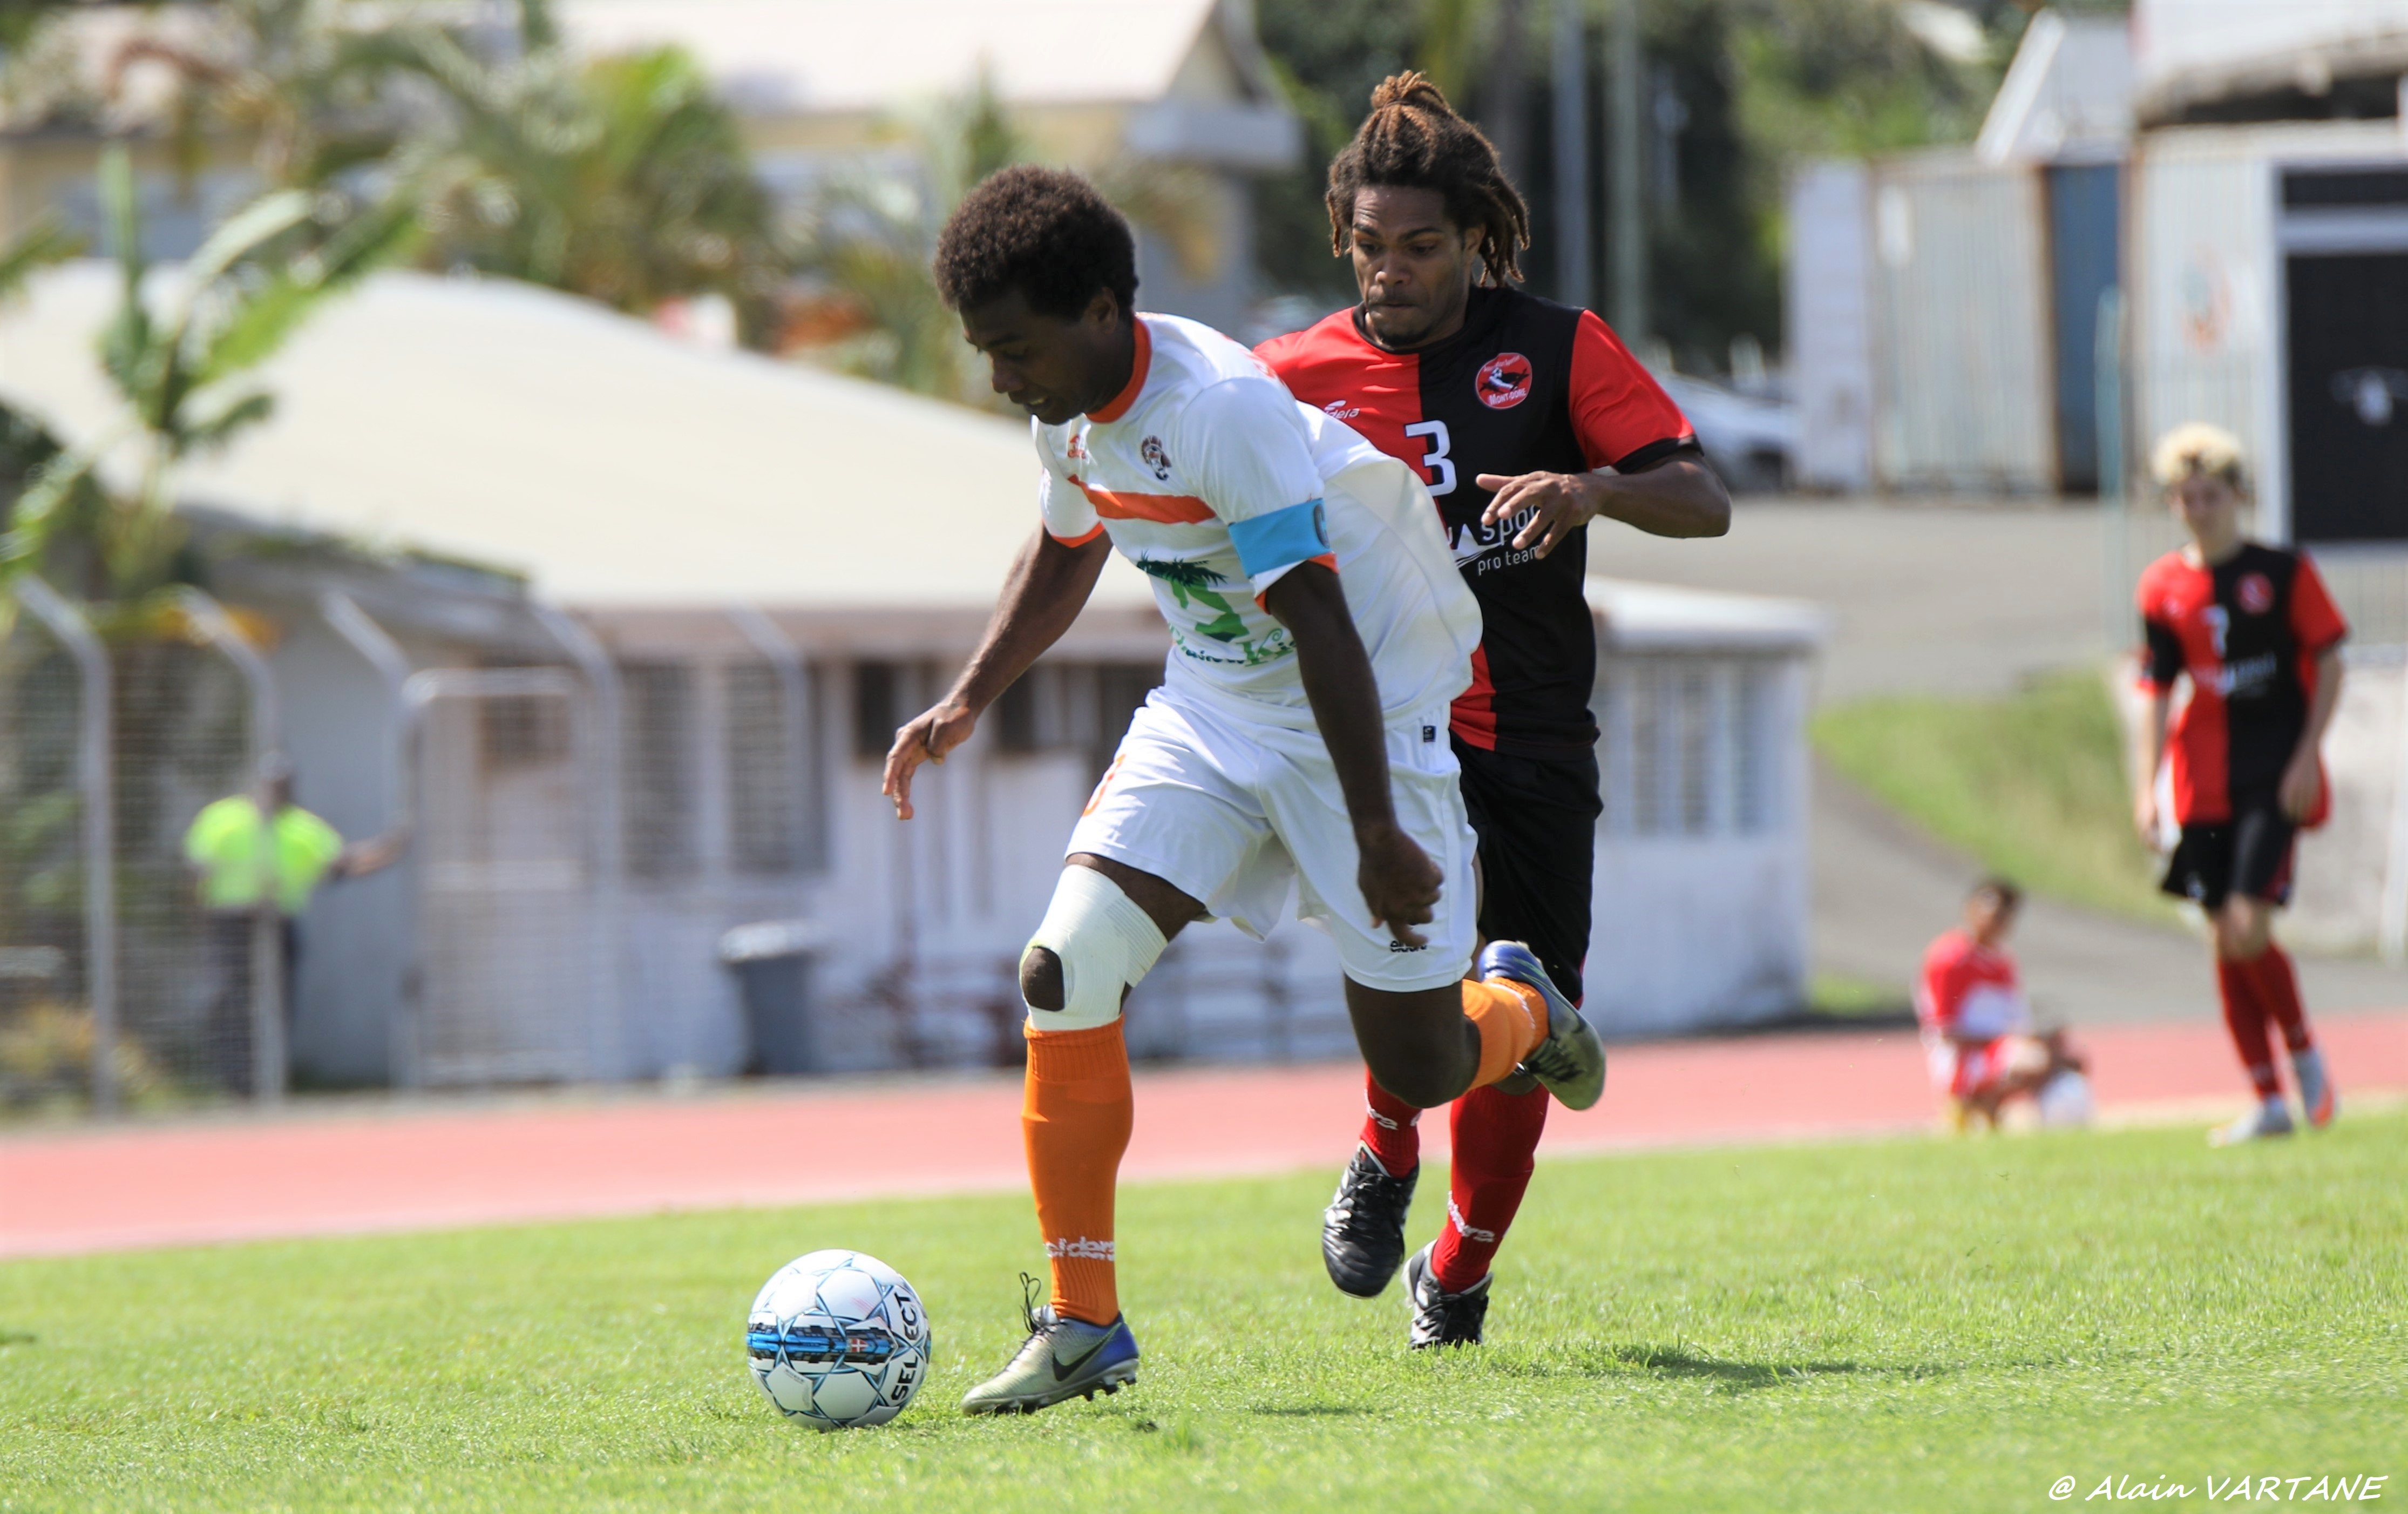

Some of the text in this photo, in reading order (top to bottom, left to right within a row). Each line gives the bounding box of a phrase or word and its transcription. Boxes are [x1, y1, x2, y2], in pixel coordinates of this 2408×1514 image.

[1405, 420, 1457, 496] 3
[1477, 557, 1502, 576] pro
[891, 1292, 919, 1401] SELECT
